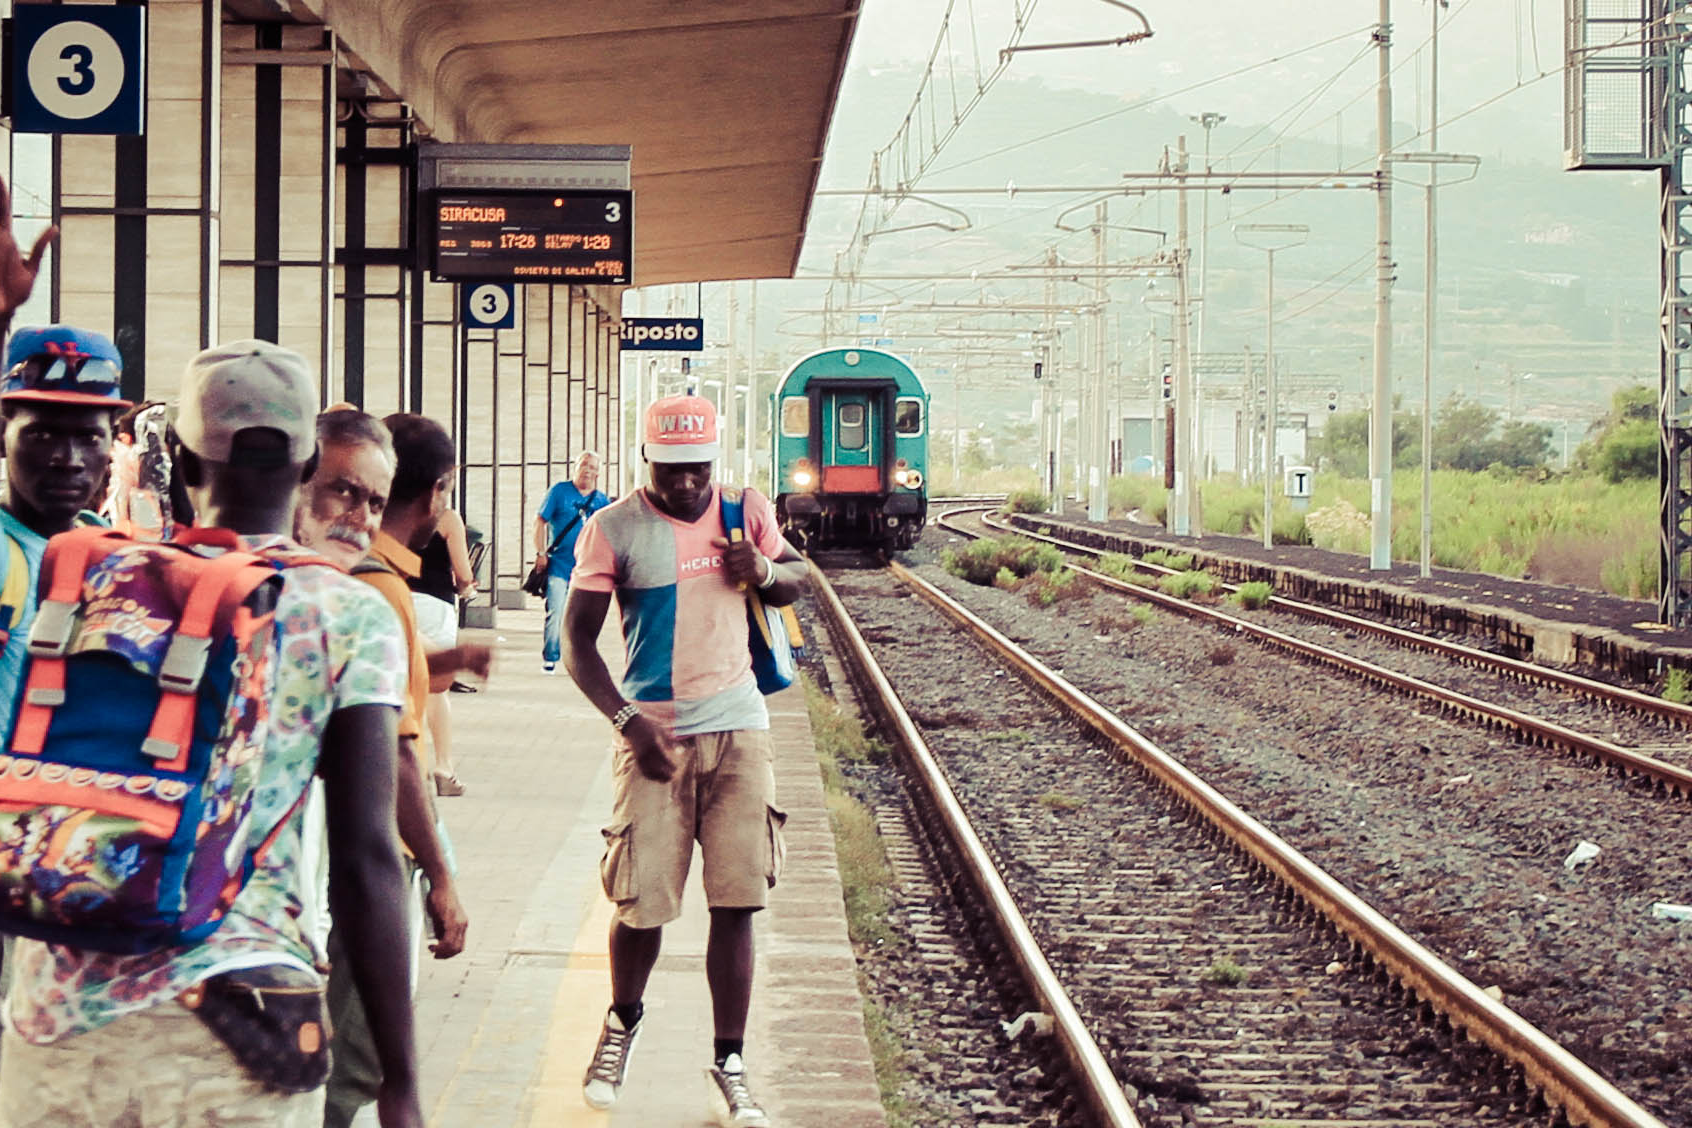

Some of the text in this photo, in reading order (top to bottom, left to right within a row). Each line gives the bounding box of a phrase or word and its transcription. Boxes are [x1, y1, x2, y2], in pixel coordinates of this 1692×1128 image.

[56, 43, 95, 96] 3
[439, 206, 507, 222] SIRACUSA
[605, 201, 621, 222] 3
[500, 233, 536, 249] 17:28
[481, 293, 497, 314] 3
[658, 414, 705, 433] WHY
[1295, 472, 1307, 493] T
[681, 555, 724, 572] HERE
